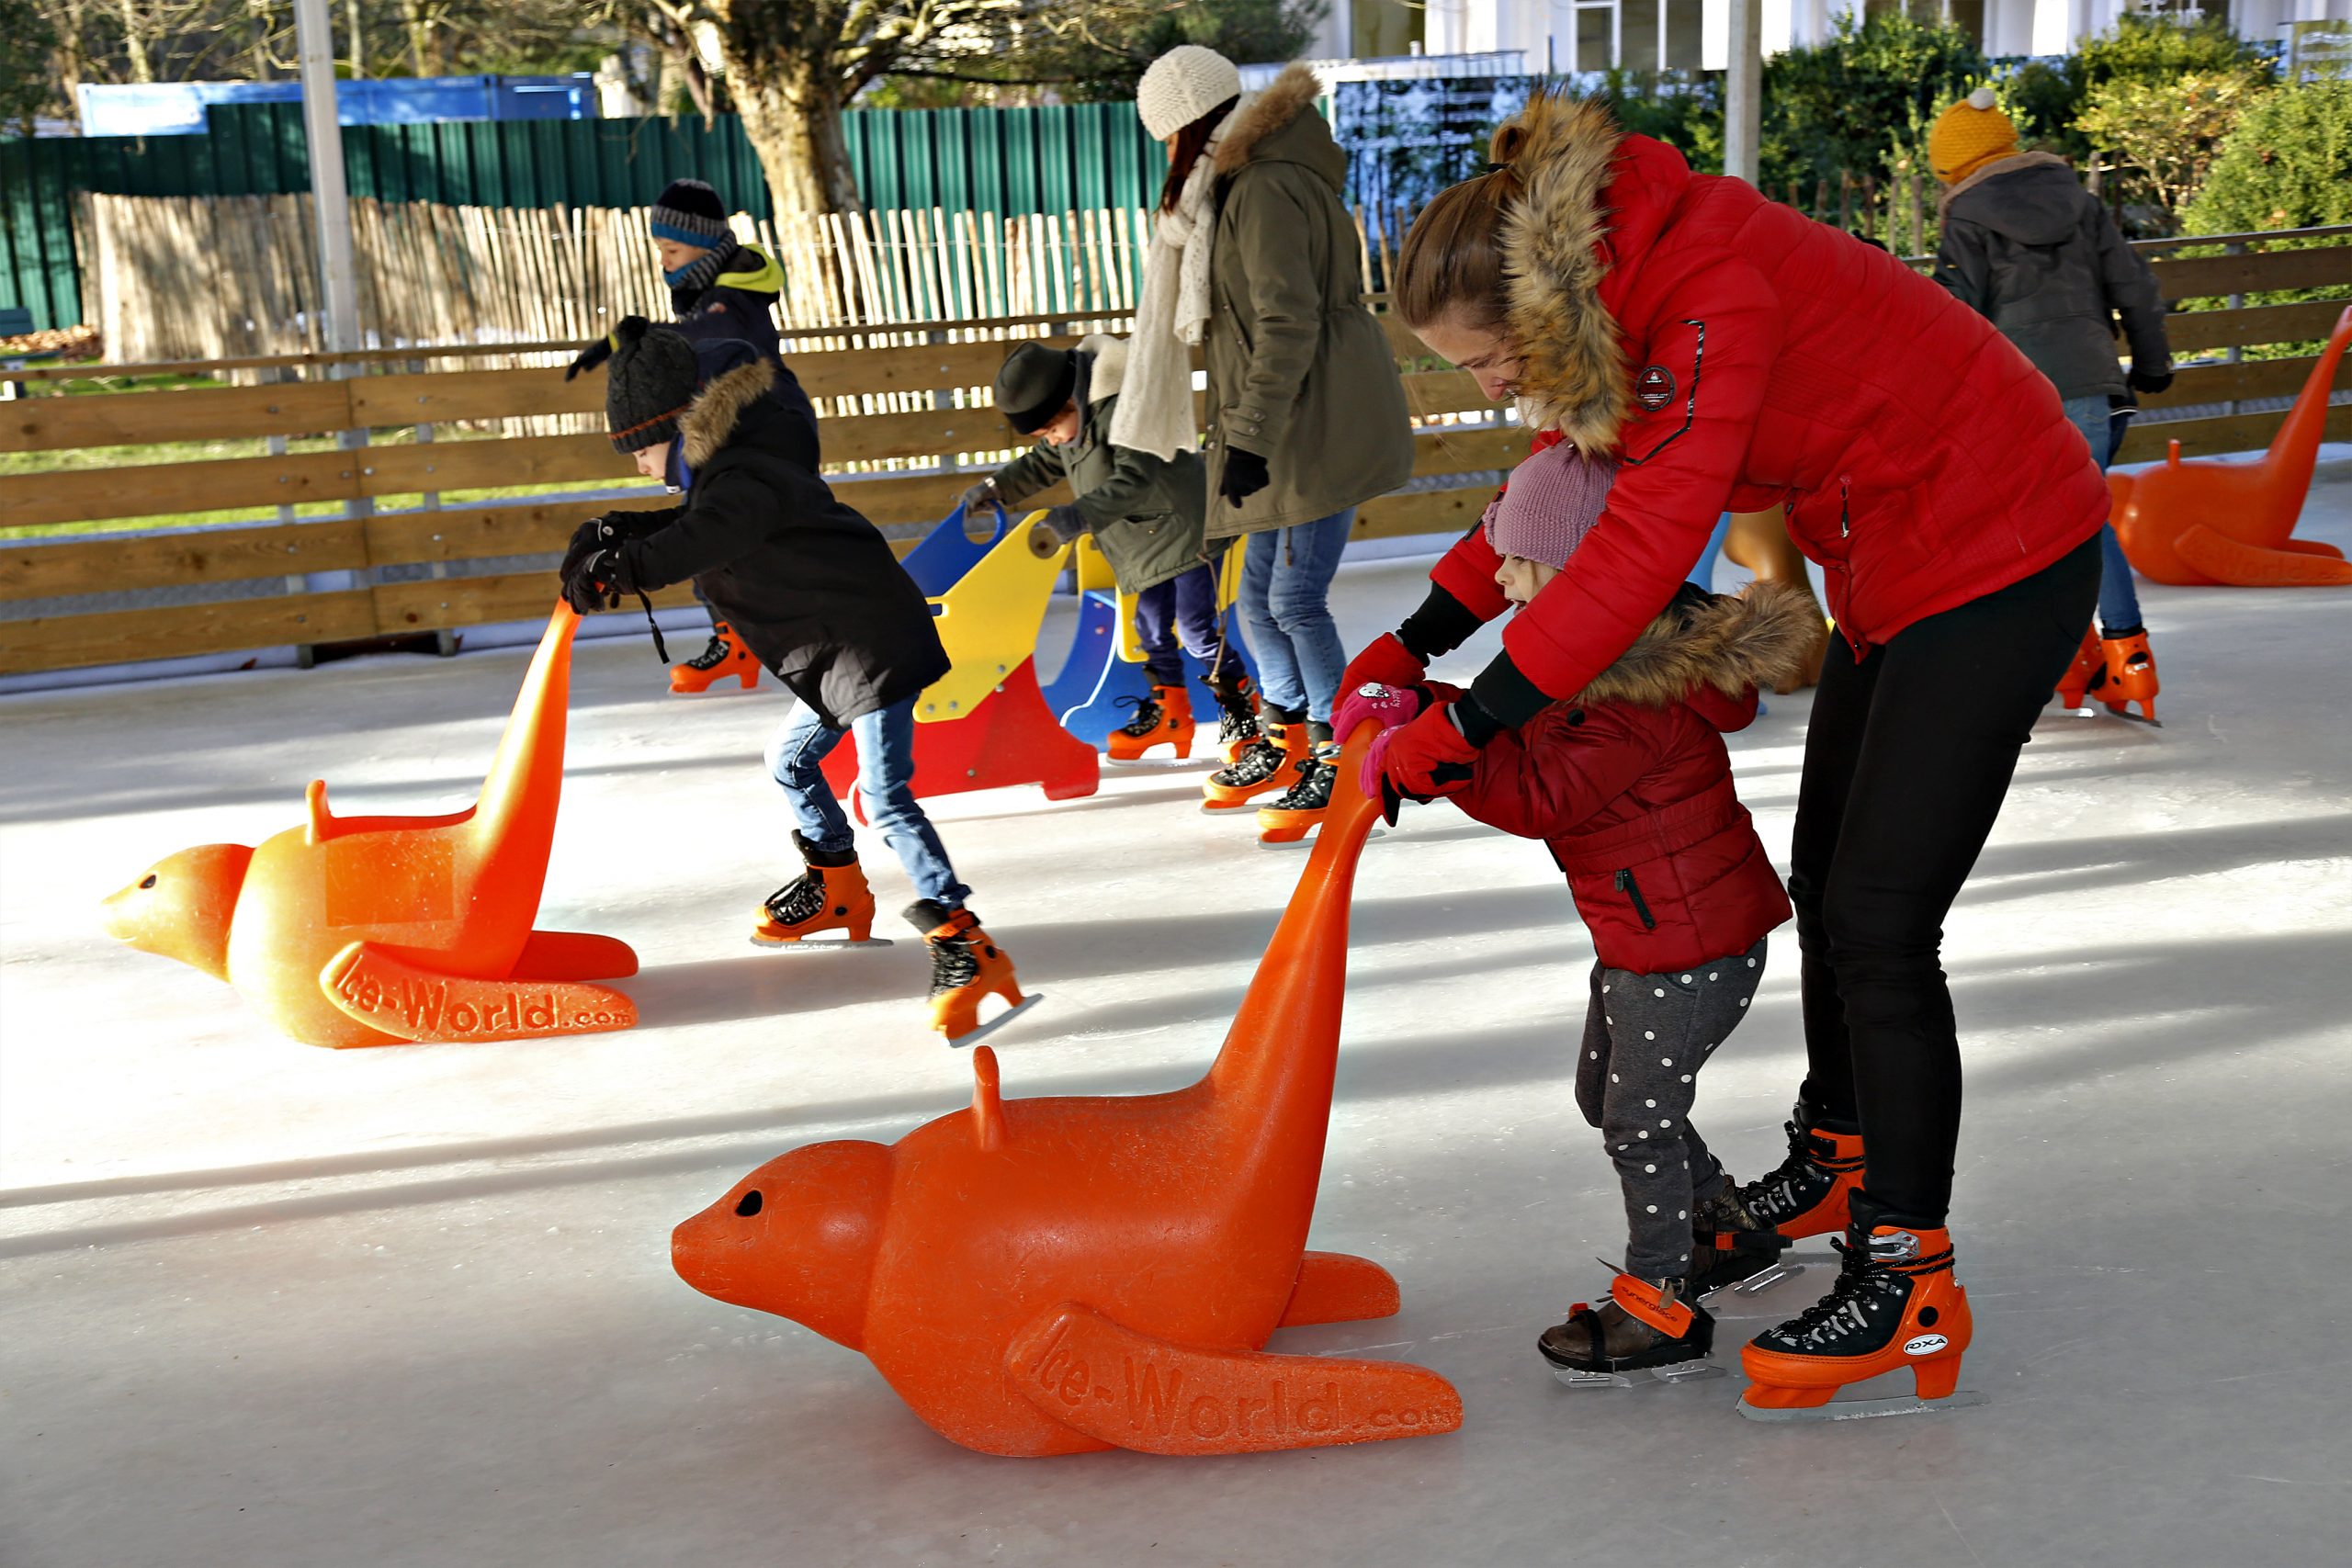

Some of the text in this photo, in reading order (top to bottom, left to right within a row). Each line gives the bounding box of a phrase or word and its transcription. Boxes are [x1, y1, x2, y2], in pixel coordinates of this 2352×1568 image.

[336, 953, 632, 1032] Ice-World.com
[1031, 1323, 1453, 1438] Ice-World.com
[1905, 1337, 1947, 1351] ROXA
